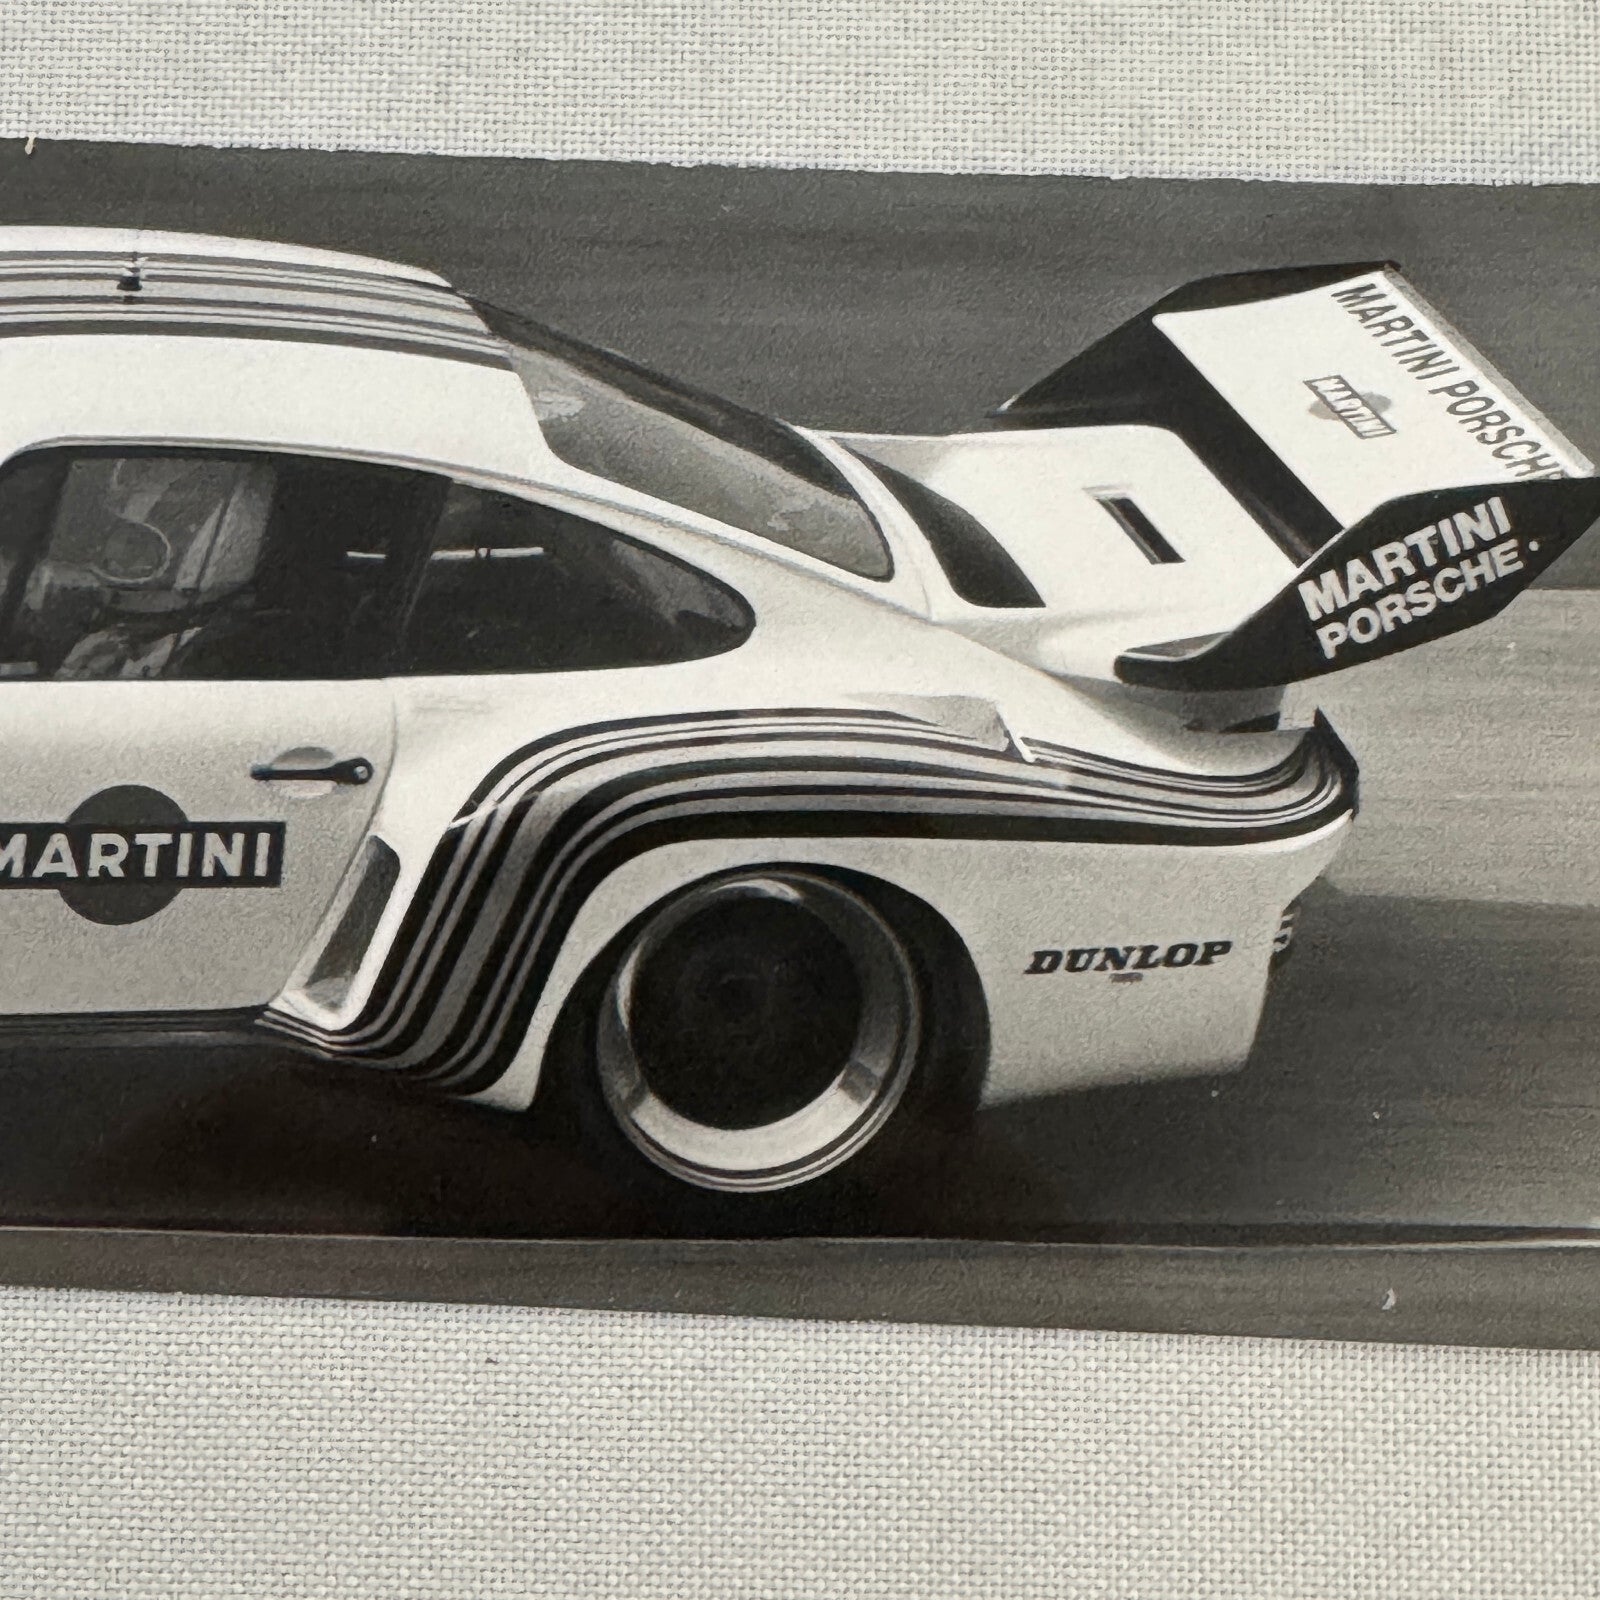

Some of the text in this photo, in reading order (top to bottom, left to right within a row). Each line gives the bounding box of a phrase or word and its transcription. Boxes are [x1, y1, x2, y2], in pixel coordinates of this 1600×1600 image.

[1331, 283, 1460, 380] MARTINI
[1298, 496, 1511, 621] MARTINI
[1023, 940, 1233, 974] DUNLOP
